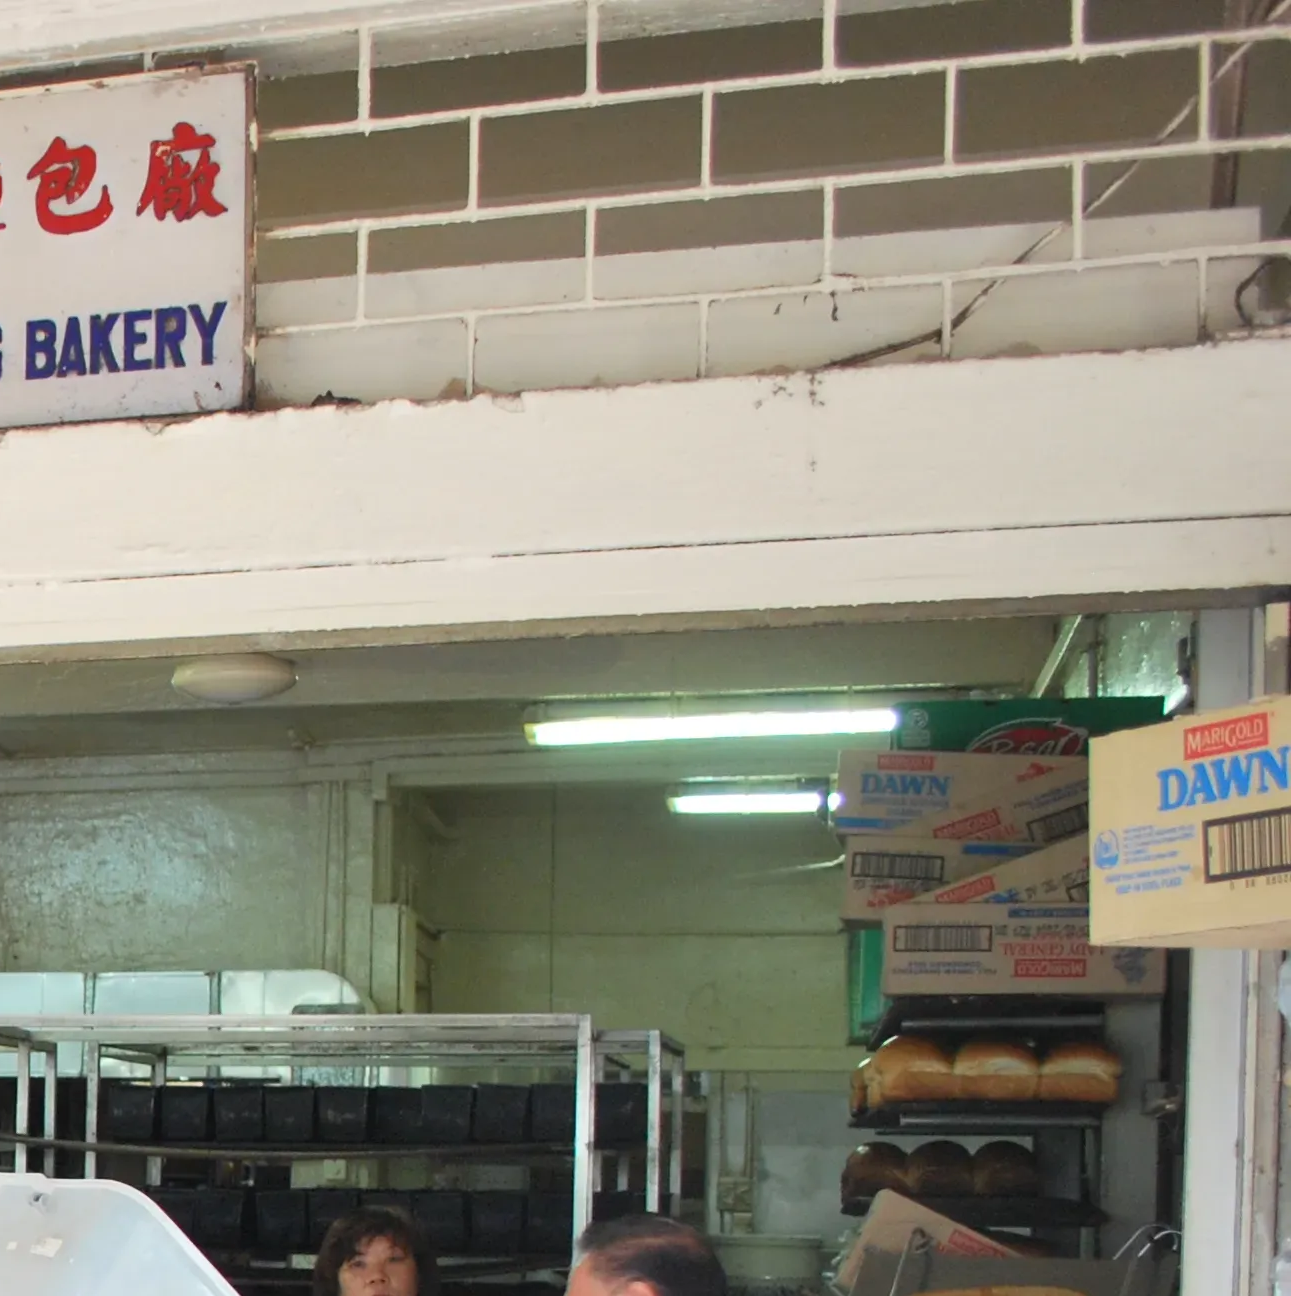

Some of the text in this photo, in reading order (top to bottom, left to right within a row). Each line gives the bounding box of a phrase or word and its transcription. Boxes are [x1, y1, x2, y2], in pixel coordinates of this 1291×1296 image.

[25, 301, 228, 381] BAKERY
[1186, 717, 1264, 754] MARIGOLD
[860, 773, 952, 796] DAWN
[1157, 746, 1291, 812] DAWN
